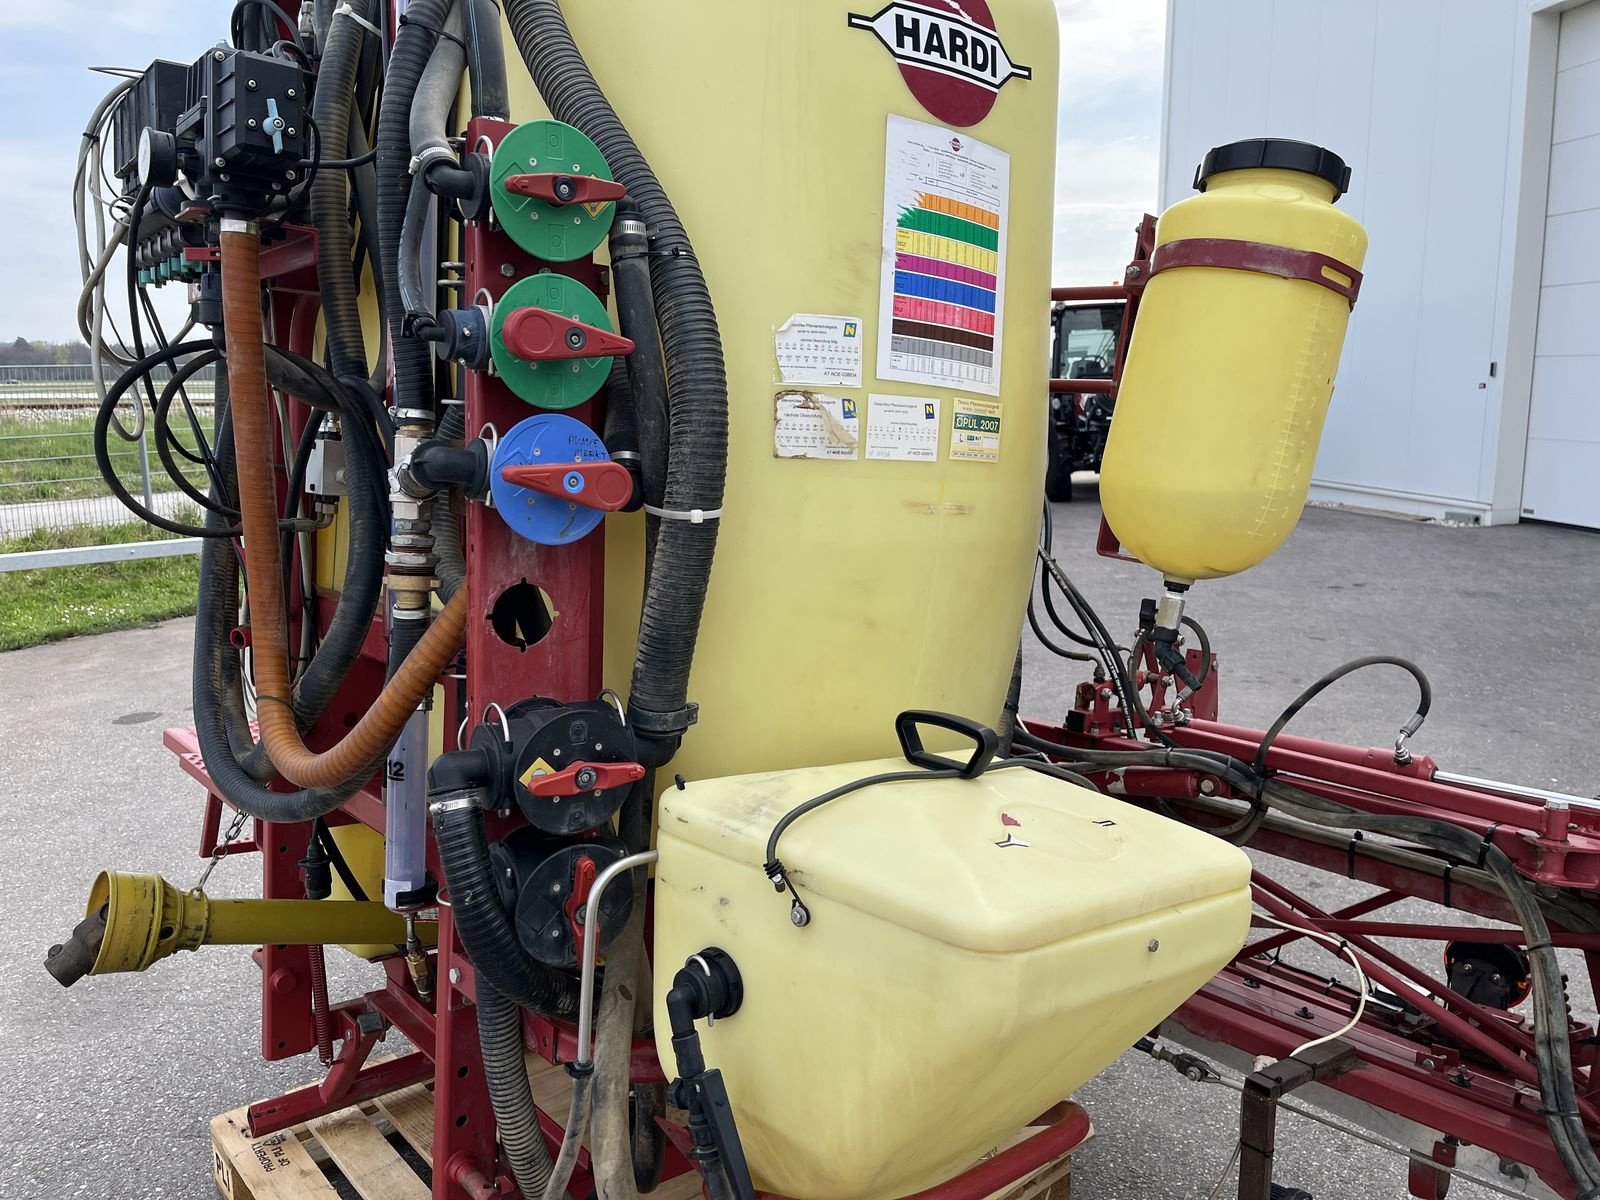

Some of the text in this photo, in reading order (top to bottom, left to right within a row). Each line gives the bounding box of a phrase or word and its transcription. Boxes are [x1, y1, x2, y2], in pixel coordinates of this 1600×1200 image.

[895, 13, 997, 78] HARDI
[844, 400, 855, 412] N
[980, 419, 999, 431] 2007
[251, 1142, 276, 1173] PROPERTY
[278, 1157, 290, 1167] OF
